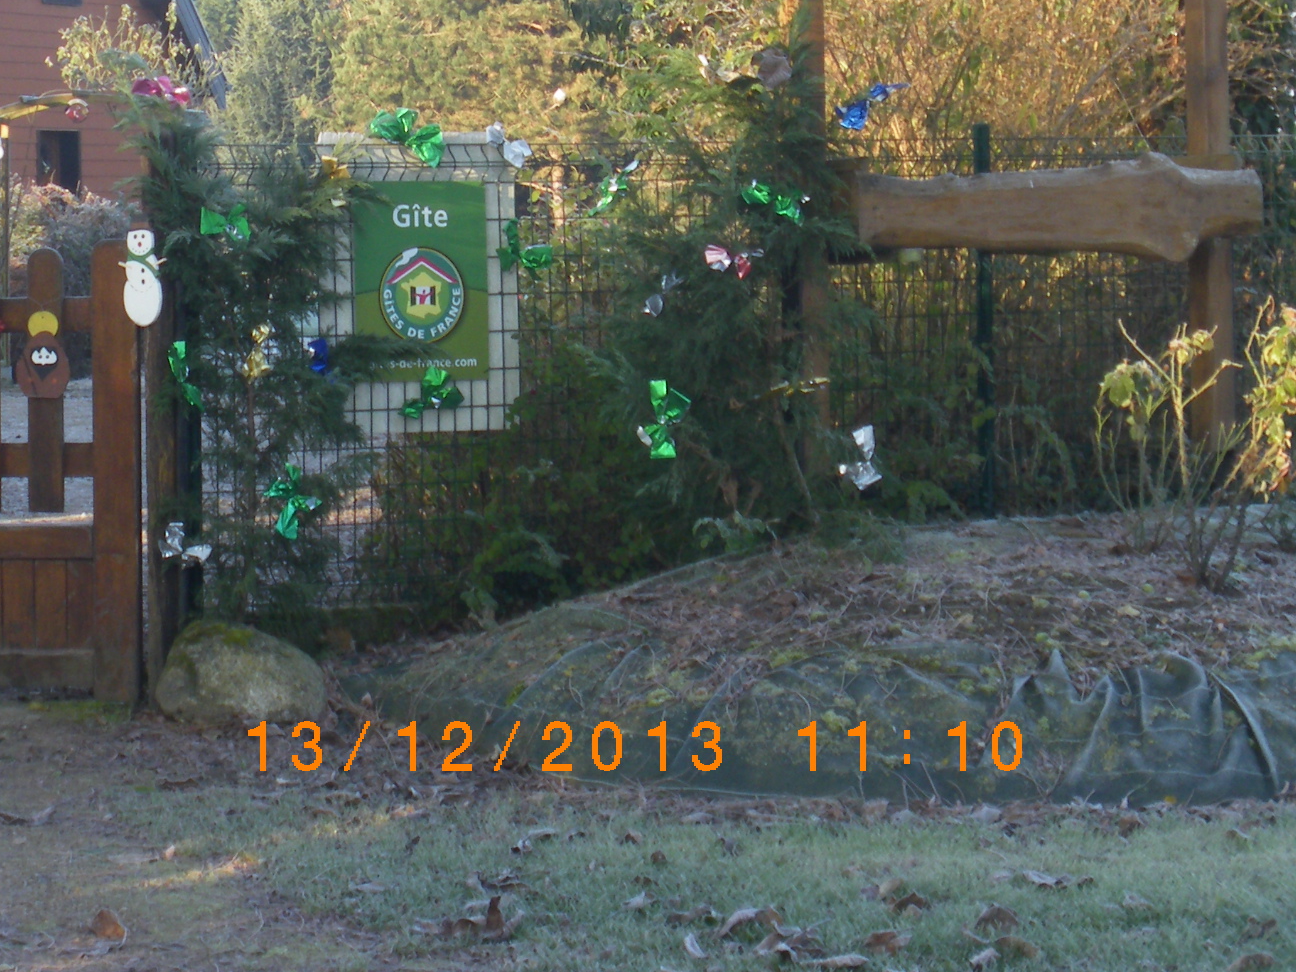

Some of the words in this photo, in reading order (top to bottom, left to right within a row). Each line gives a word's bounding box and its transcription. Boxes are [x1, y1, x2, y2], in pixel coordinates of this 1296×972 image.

[392, 204, 448, 228] Gîte
[407, 327, 425, 339] DE
[430, 288, 461, 338] FRANCE
